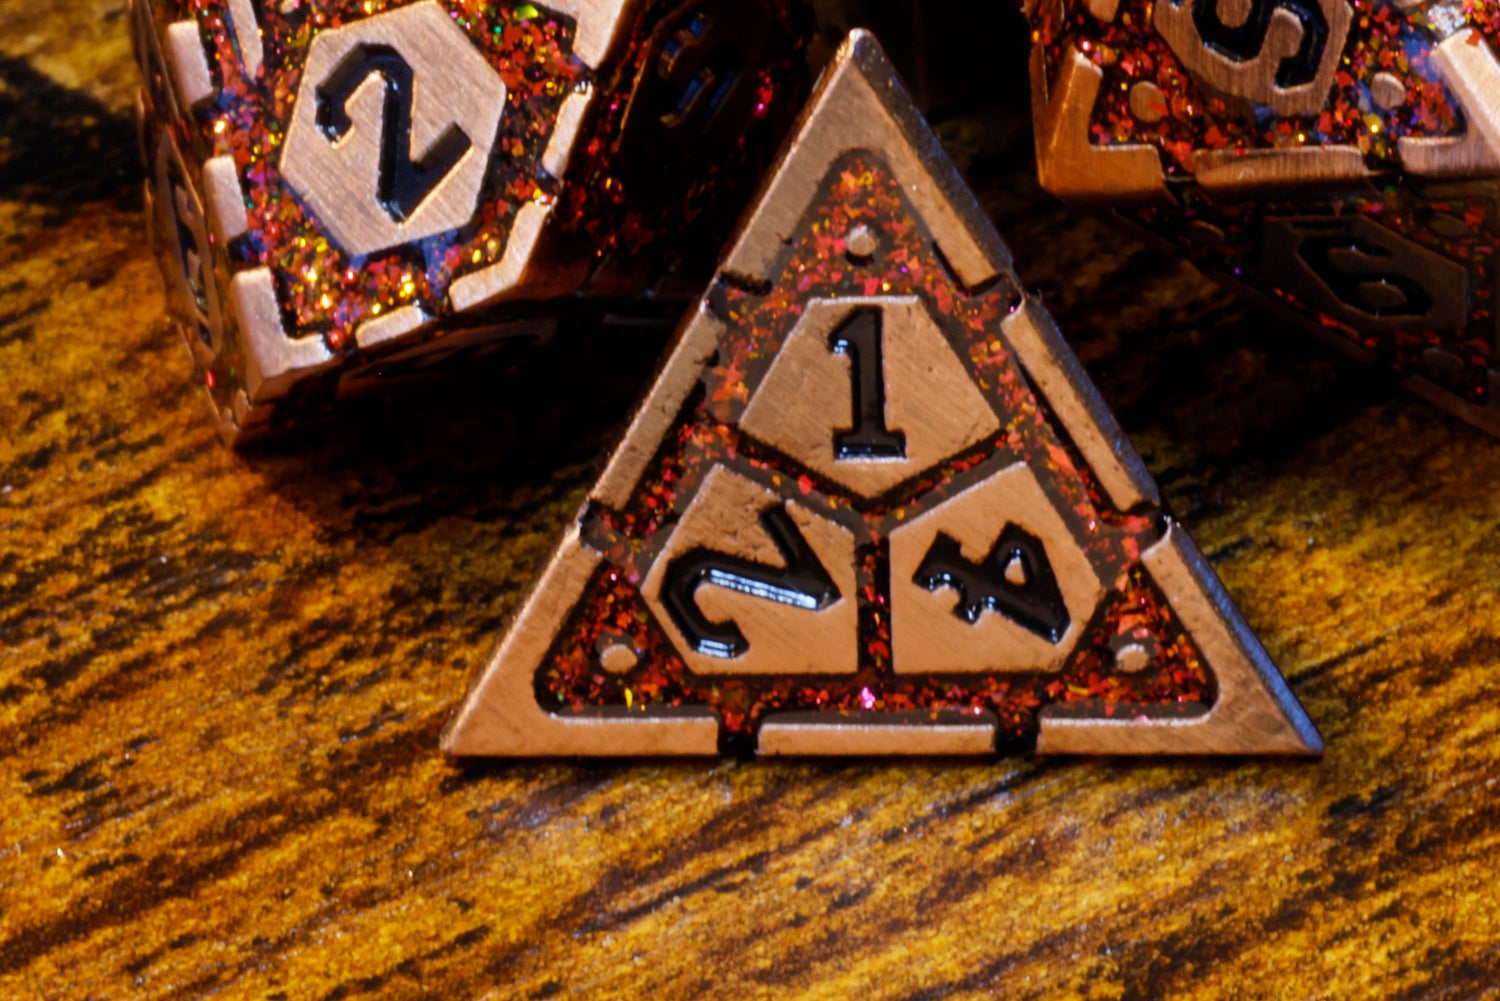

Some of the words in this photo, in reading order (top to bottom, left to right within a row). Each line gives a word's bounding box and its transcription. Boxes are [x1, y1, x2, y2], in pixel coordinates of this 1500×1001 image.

[315, 43, 474, 225] 2
[826, 306, 908, 462] 1
[663, 506, 844, 660] 2
[911, 522, 1072, 645] 4
